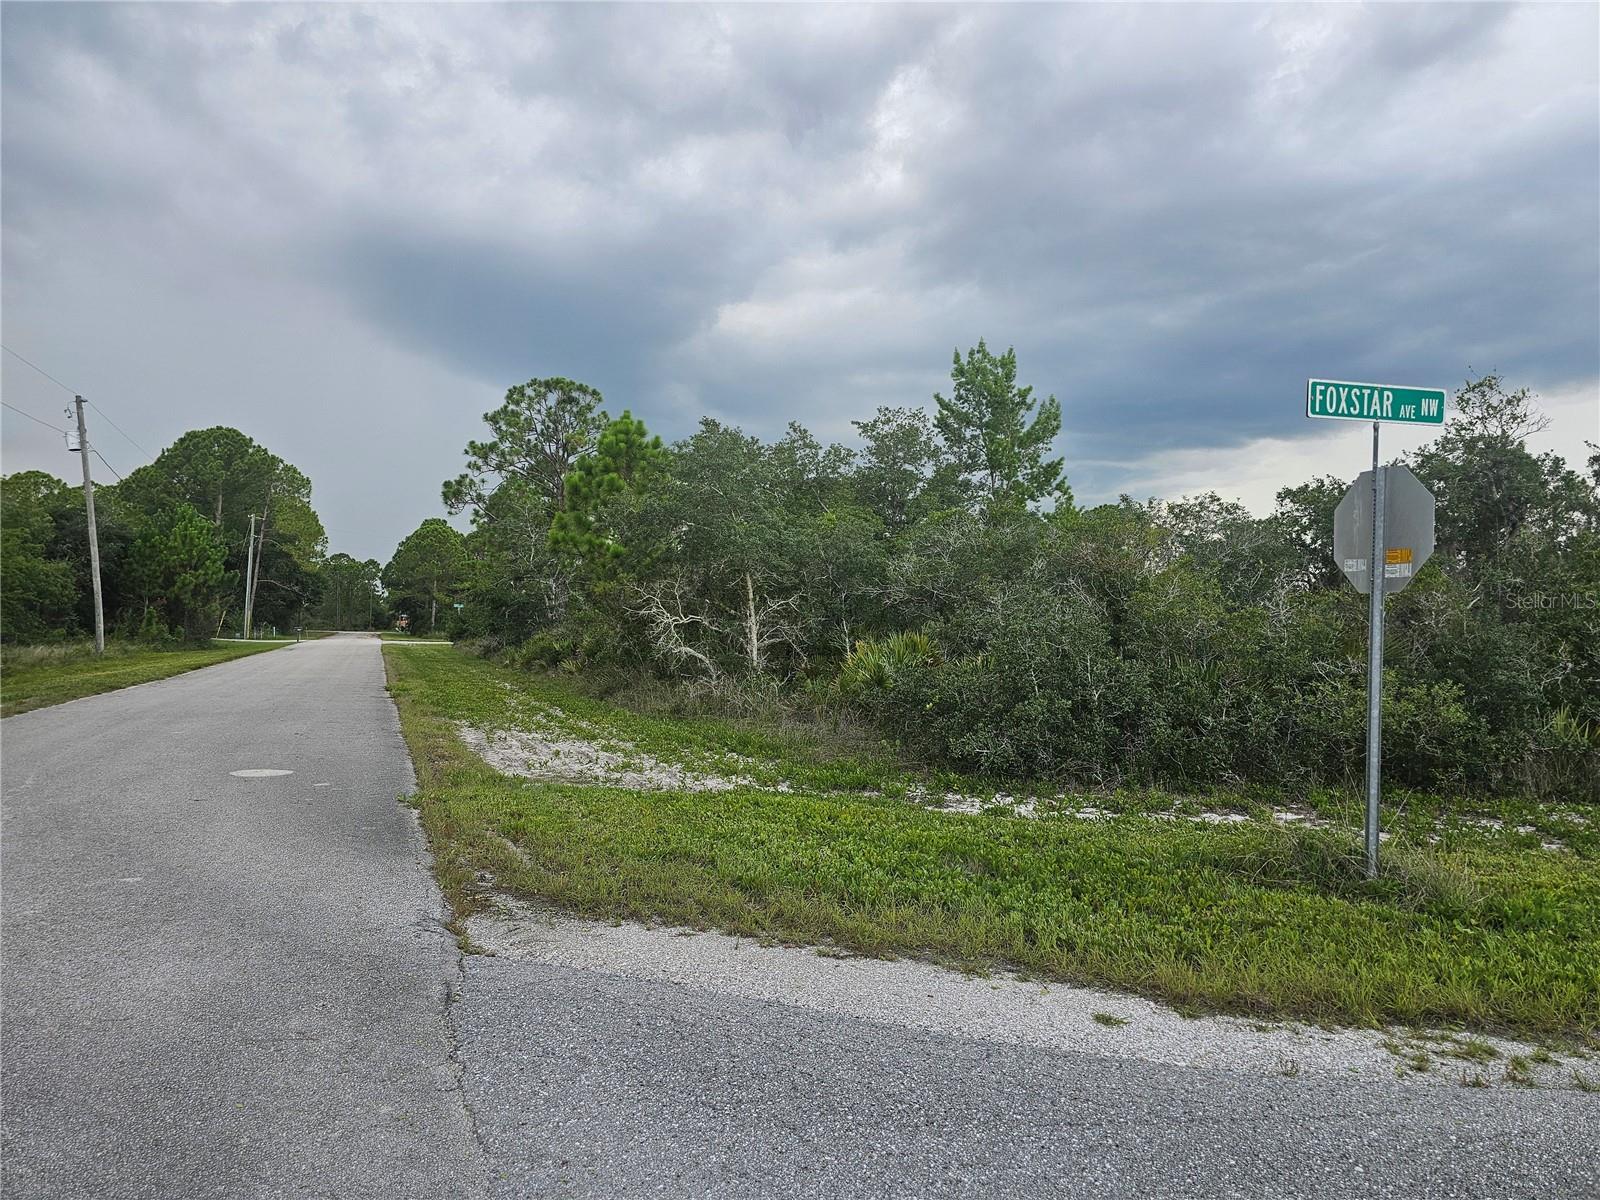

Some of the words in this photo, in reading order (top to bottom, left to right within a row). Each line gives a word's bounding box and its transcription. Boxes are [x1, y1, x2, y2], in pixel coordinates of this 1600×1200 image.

[1315, 385, 1393, 418] FOXSTAR
[1399, 405, 1416, 419] AVE
[1421, 398, 1439, 417] NW
